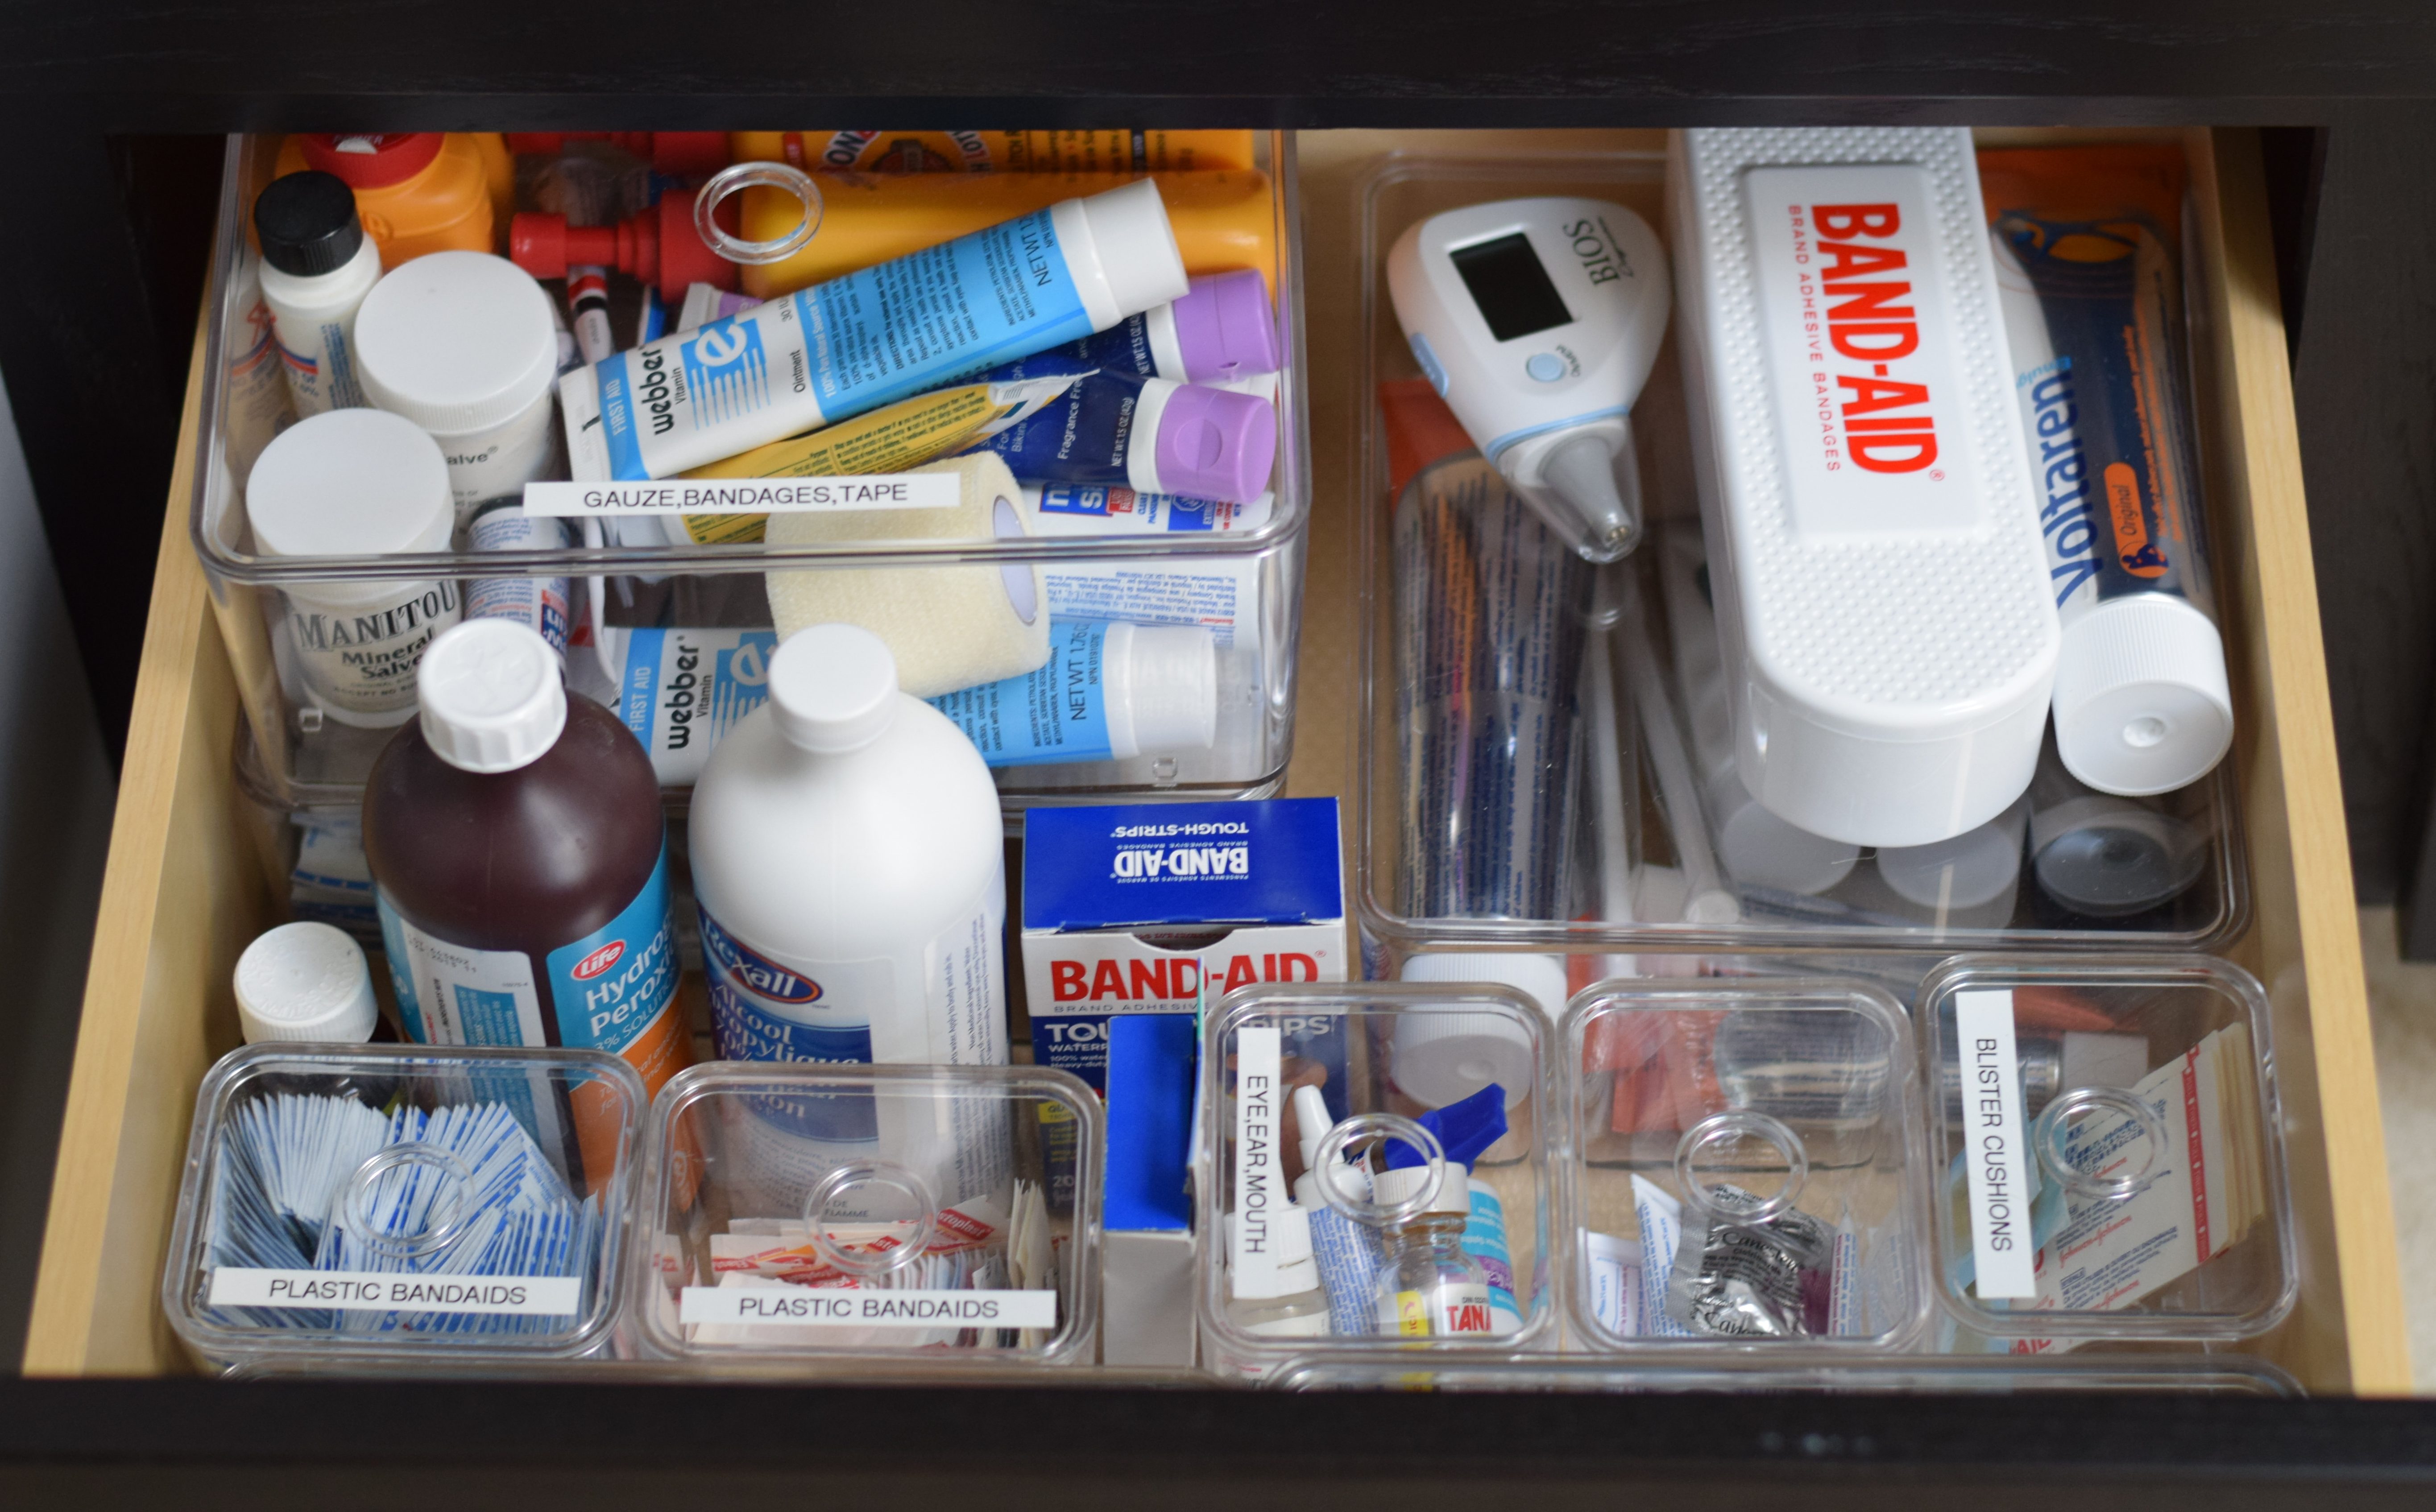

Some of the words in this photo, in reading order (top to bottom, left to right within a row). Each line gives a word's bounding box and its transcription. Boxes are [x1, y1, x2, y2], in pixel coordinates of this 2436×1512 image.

[1562, 217, 1620, 286] BIOS
[1788, 205, 1810, 265] BRAND
[1799, 273, 1824, 362] ADHESIVE
[1813, 372, 1840, 472] BANDAGES
[1810, 203, 1939, 474] BAND-AID
[605, 378, 622, 398] AID
[642, 348, 675, 435] webber
[670, 367, 687, 404] Vitamin
[788, 349, 806, 392] Ointment
[608, 400, 627, 436] FIRST
[1058, 402, 1079, 459] Fragrance
[447, 452, 488, 465] alve
[584, 483, 908, 510] GAUZE,BANDAGES,TAPE
[2031, 368, 2107, 609] Voltaren
[2119, 484, 2138, 536] Original
[295, 581, 455, 651] MANITOU
[341, 627, 433, 665] Mineral
[638, 666, 652, 690] AID
[667, 644, 699, 751] webber
[696, 674, 713, 718] Vitamin
[630, 690, 648, 732] FIRST
[1115, 822, 1249, 838] TOUGH-STRIPS
[1114, 847, 1249, 877] BAND-AID
[580, 945, 620, 977] Life
[704, 919, 797, 996] Rexall
[716, 984, 793, 1045] Alcool
[1054, 1004, 1114, 1013] BRAND
[1976, 1038, 2003, 1127] BLISTER
[1243, 1075, 1269, 1254] EYE,EAR,MOUTH
[1984, 1136, 2013, 1252] CUSHIONS
[269, 1279, 381, 1301] PLASTIC
[391, 1282, 527, 1305] BANDAIDS
[739, 1298, 852, 1318] PLASTIC
[862, 1300, 999, 1318] BANDAIDS
